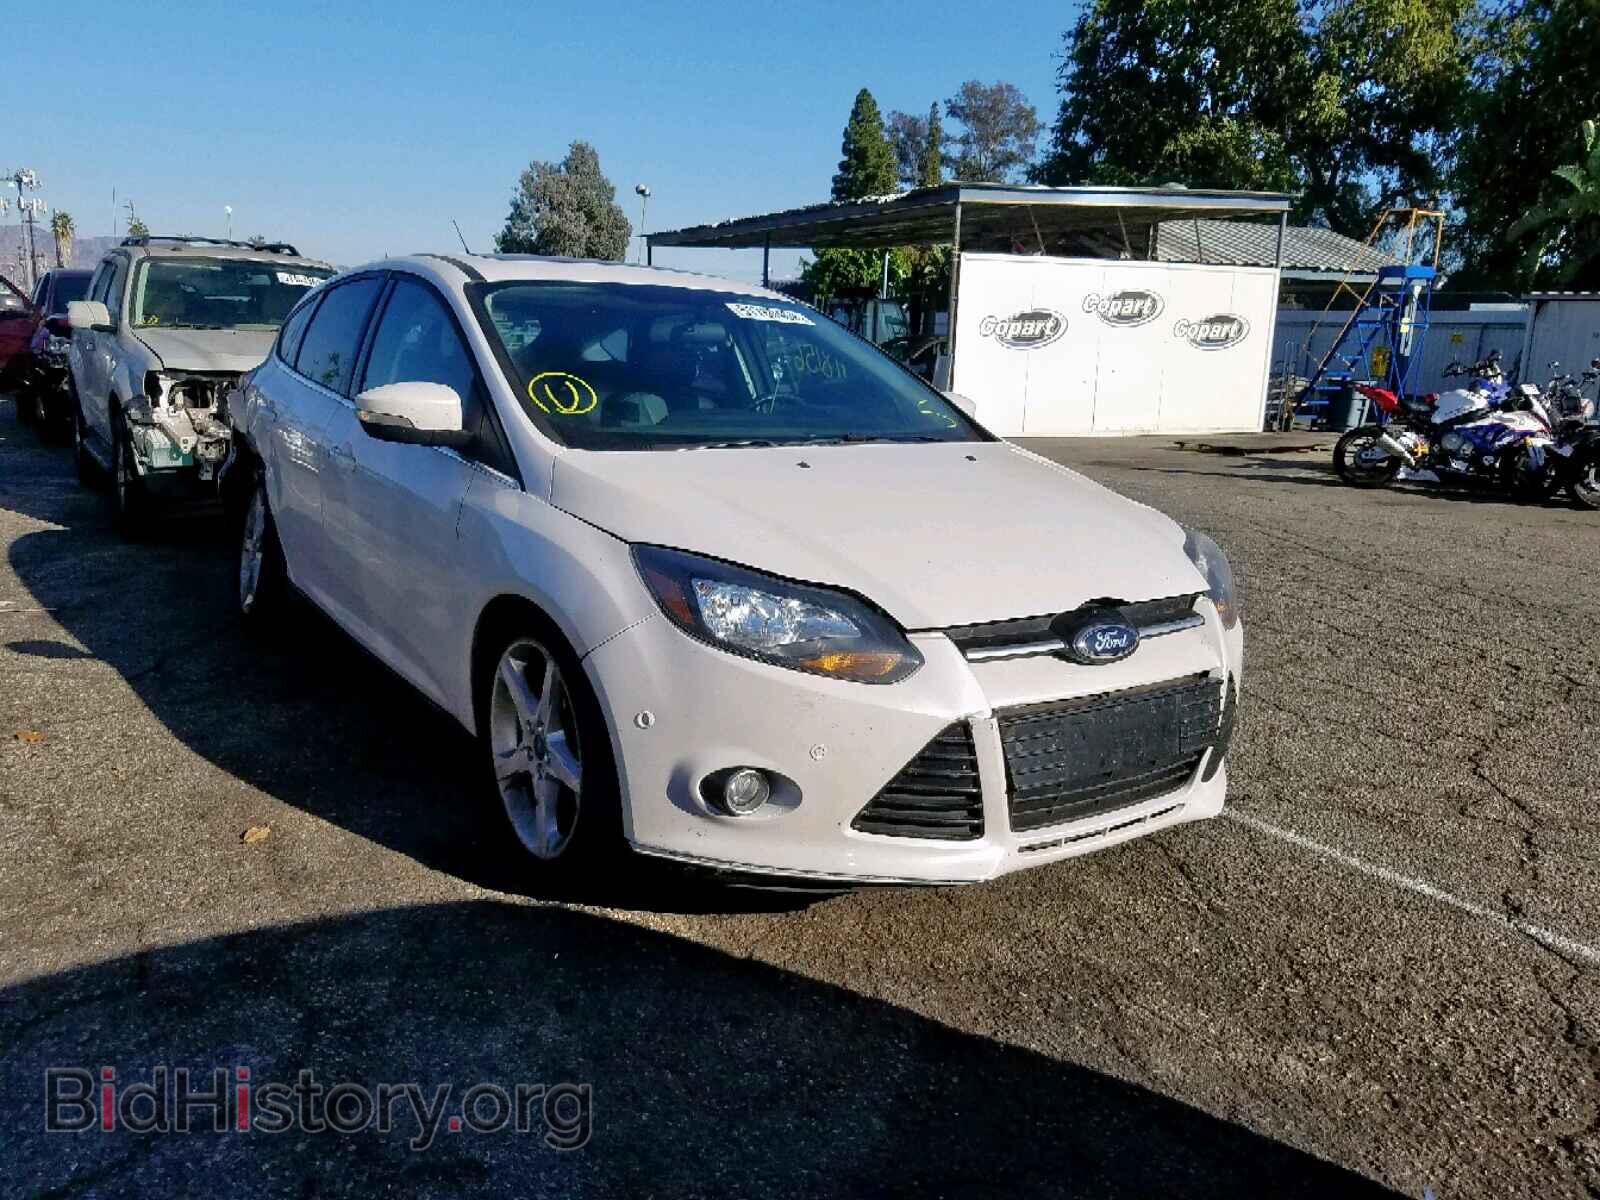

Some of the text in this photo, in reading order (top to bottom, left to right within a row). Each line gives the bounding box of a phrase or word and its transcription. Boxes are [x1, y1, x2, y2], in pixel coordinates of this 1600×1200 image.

[1082, 292, 1153, 319] Copart
[980, 315, 1058, 339] Copart
[1174, 318, 1240, 341] Copart
[1095, 630, 1128, 651] Ford
